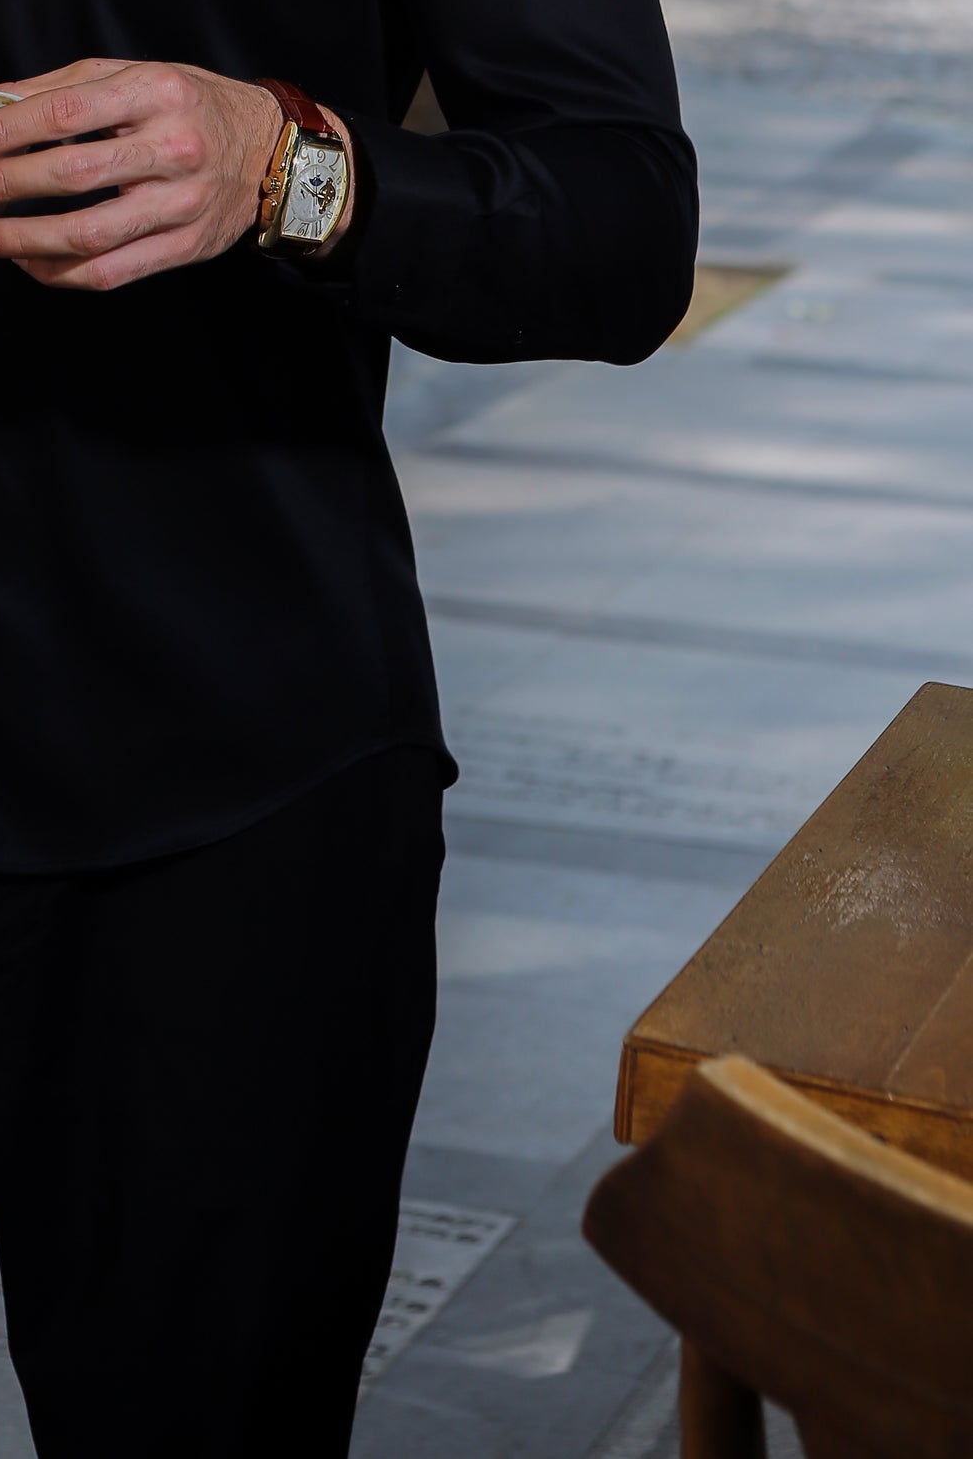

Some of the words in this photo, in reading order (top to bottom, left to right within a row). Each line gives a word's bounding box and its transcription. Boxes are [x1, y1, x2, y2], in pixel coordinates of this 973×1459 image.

[317, 150, 326, 163] 6
[329, 153, 340, 172] 7
[297, 222, 309, 237] 12
[315, 220, 322, 238] 11
